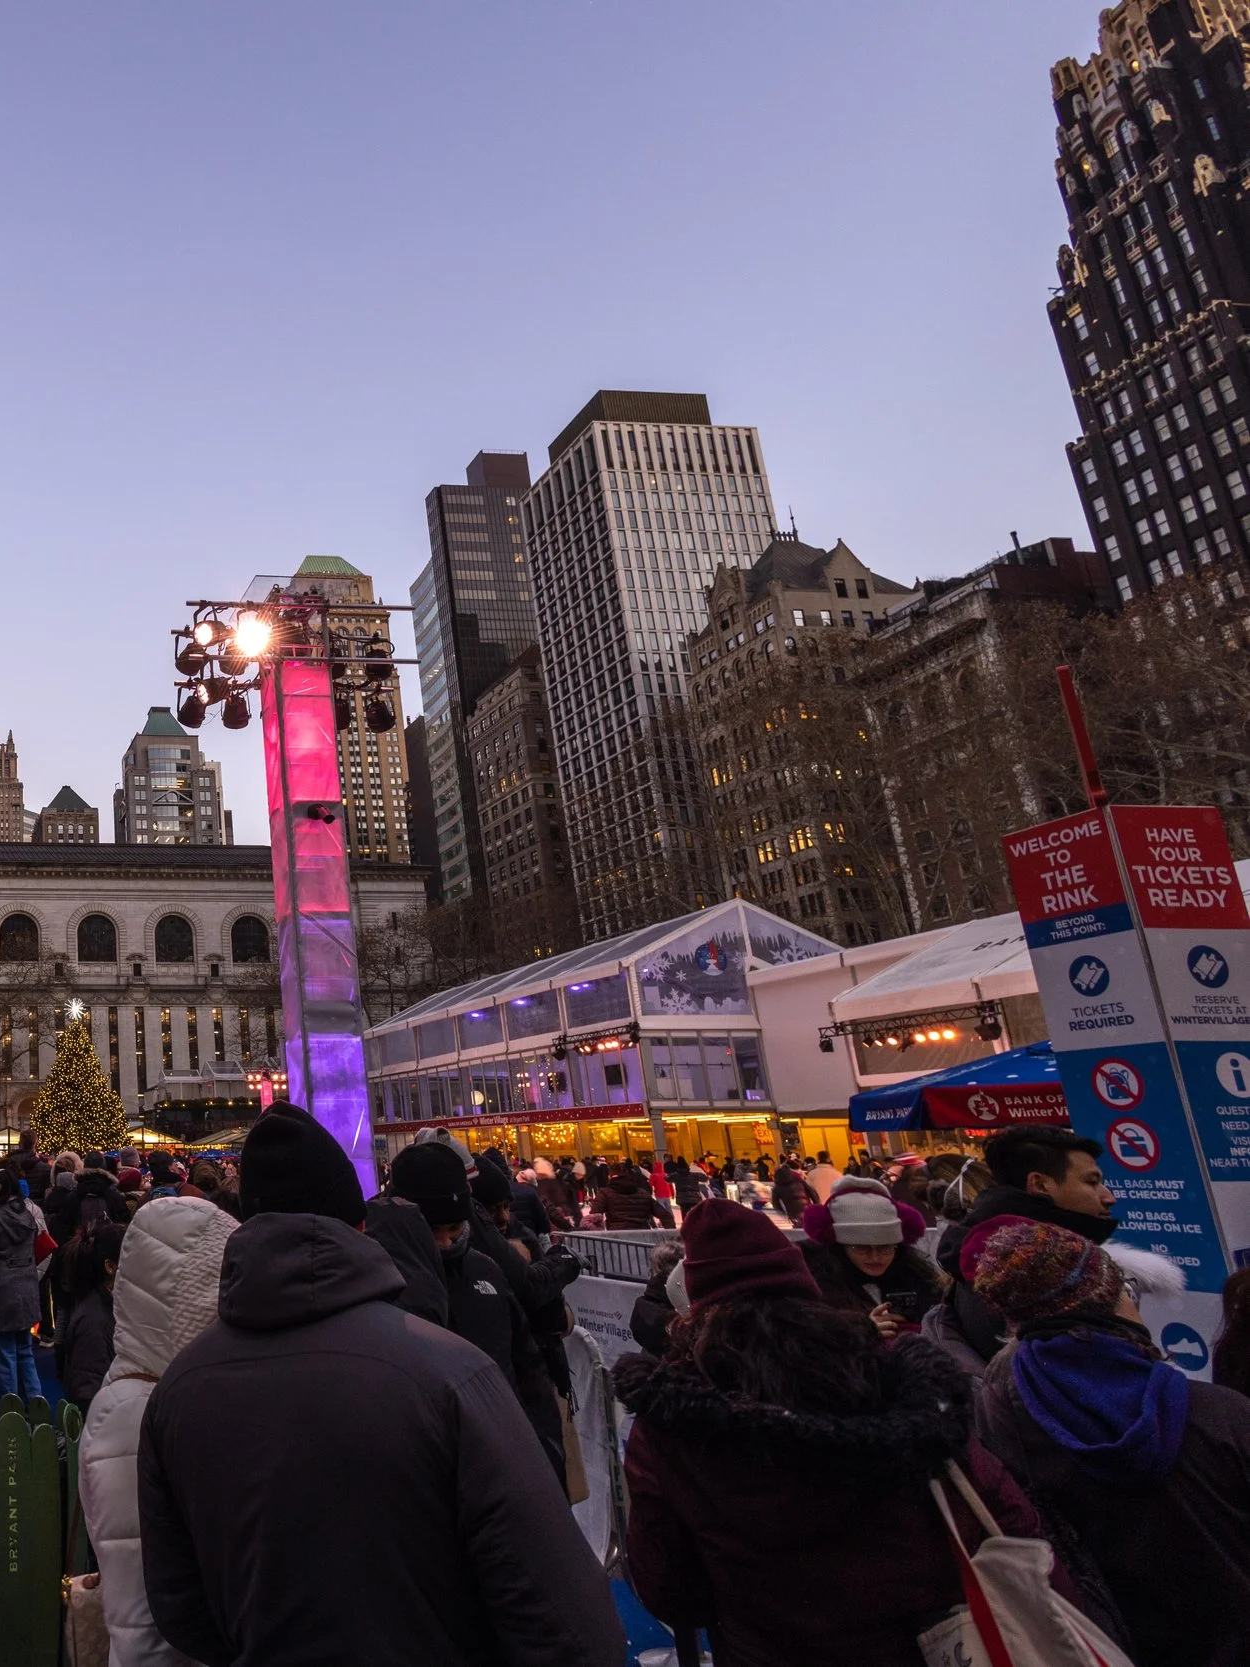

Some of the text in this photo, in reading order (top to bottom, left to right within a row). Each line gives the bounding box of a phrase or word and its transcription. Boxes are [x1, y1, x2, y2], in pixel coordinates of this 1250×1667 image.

[1010, 820, 1102, 858] WELCOME
[1146, 828, 1196, 843] HAVE
[1045, 850, 1070, 867] TO
[1150, 847, 1201, 862] YOUR
[1040, 864, 1087, 890] THE
[1132, 866, 1232, 885] TICKETS
[1042, 886, 1099, 914] RINK
[1147, 888, 1227, 909] READY
[1055, 914, 1095, 930] BEYOND
[1050, 922, 1106, 941] THIS POINT:
[1195, 995, 1240, 1004] RESERVE
[1071, 1002, 1124, 1018] TICKETS
[1192, 1005, 1247, 1014] TICKETS AT
[1069, 1014, 1134, 1031] REQUIRED
[1004, 1094, 1064, 1105] BANK OF
[866, 1109, 894, 1121] BRYANT
[1221, 1121, 1249, 1130] NEED
[1210, 1158, 1239, 1167] NEAR
[1104, 1180, 1184, 1189] ALL BAGS MUST
[1113, 1190, 1179, 1200] BE CHECKED
[1127, 1211, 1176, 1221] NO BAGS
[1118, 1221, 1202, 1233] LLOWED ON ICE
[1151, 1244, 1168, 1253] NO
[604, 1322, 632, 1341] Village
[8, 1436, 18, 1572] BRYANT PARK
